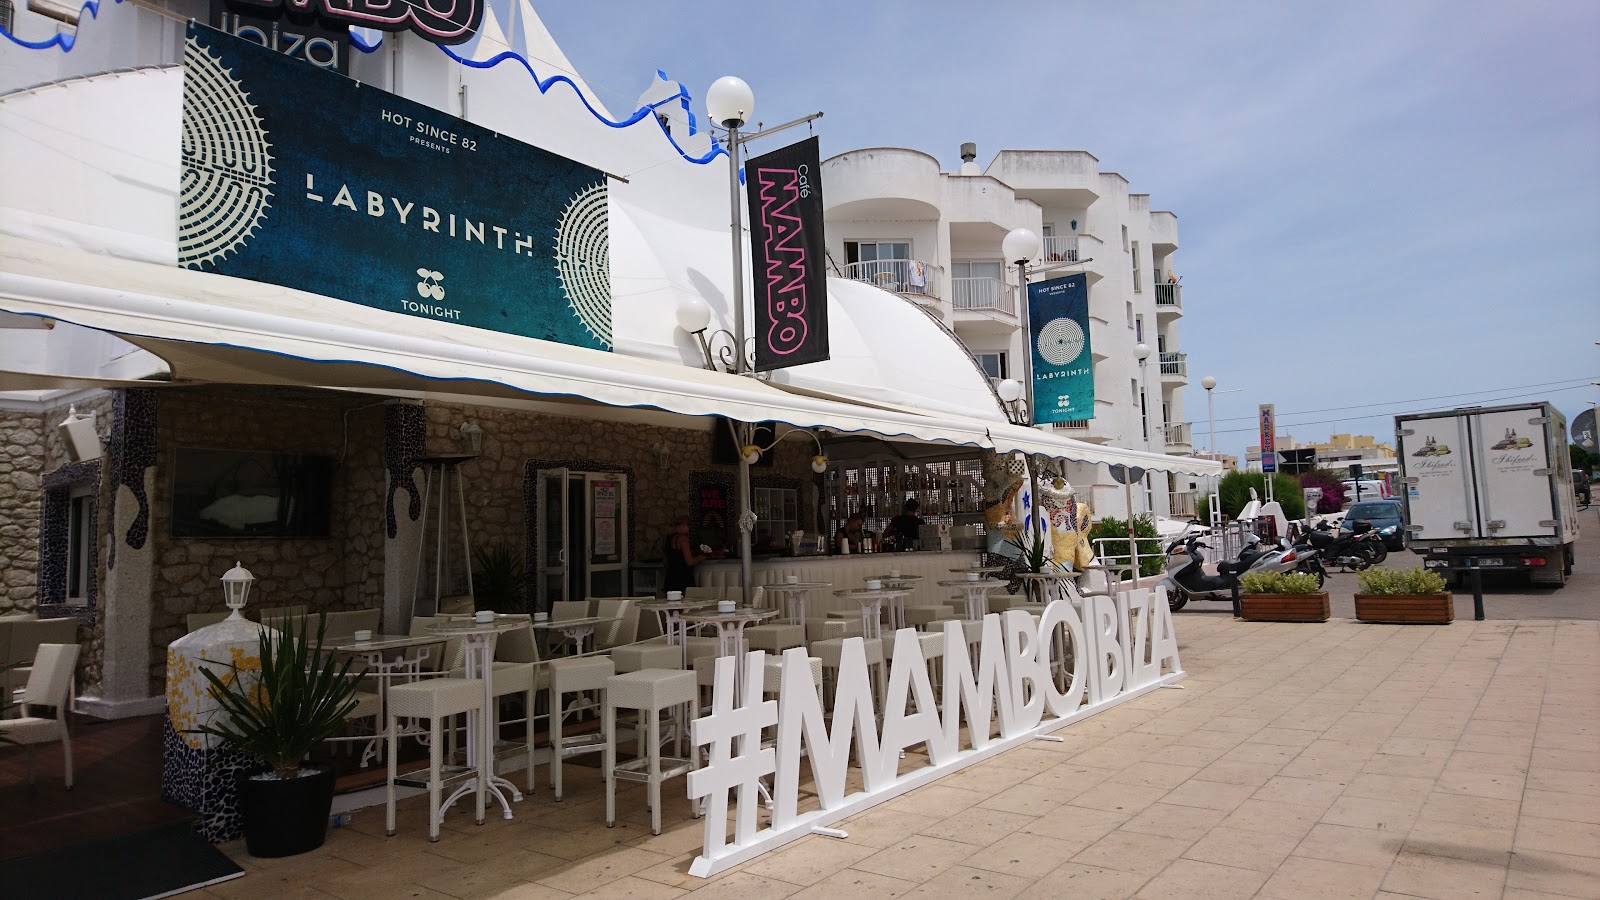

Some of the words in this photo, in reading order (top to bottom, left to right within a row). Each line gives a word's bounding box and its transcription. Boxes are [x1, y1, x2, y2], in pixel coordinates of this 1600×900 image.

[381, 109, 412, 128] HOT
[416, 121, 458, 145] SINCE
[461, 137, 477, 151] 82
[409, 135, 450, 154] PRESENTS
[798, 164, 811, 199] Café
[306, 173, 533, 257] LABYRINTH
[757, 167, 808, 355] MAMBO
[1038, 286, 1050, 294] HOT
[1050, 283, 1068, 292] SINCE
[401, 299, 461, 320] TONIGHT
[1037, 368, 1089, 380] LABYRINTH
[1262, 409, 1271, 452] MARKET
[701, 489, 720, 498] WE
[701, 499, 726, 508] ARE
[687, 585, 1182, 858] #MAMBOIBIZA
